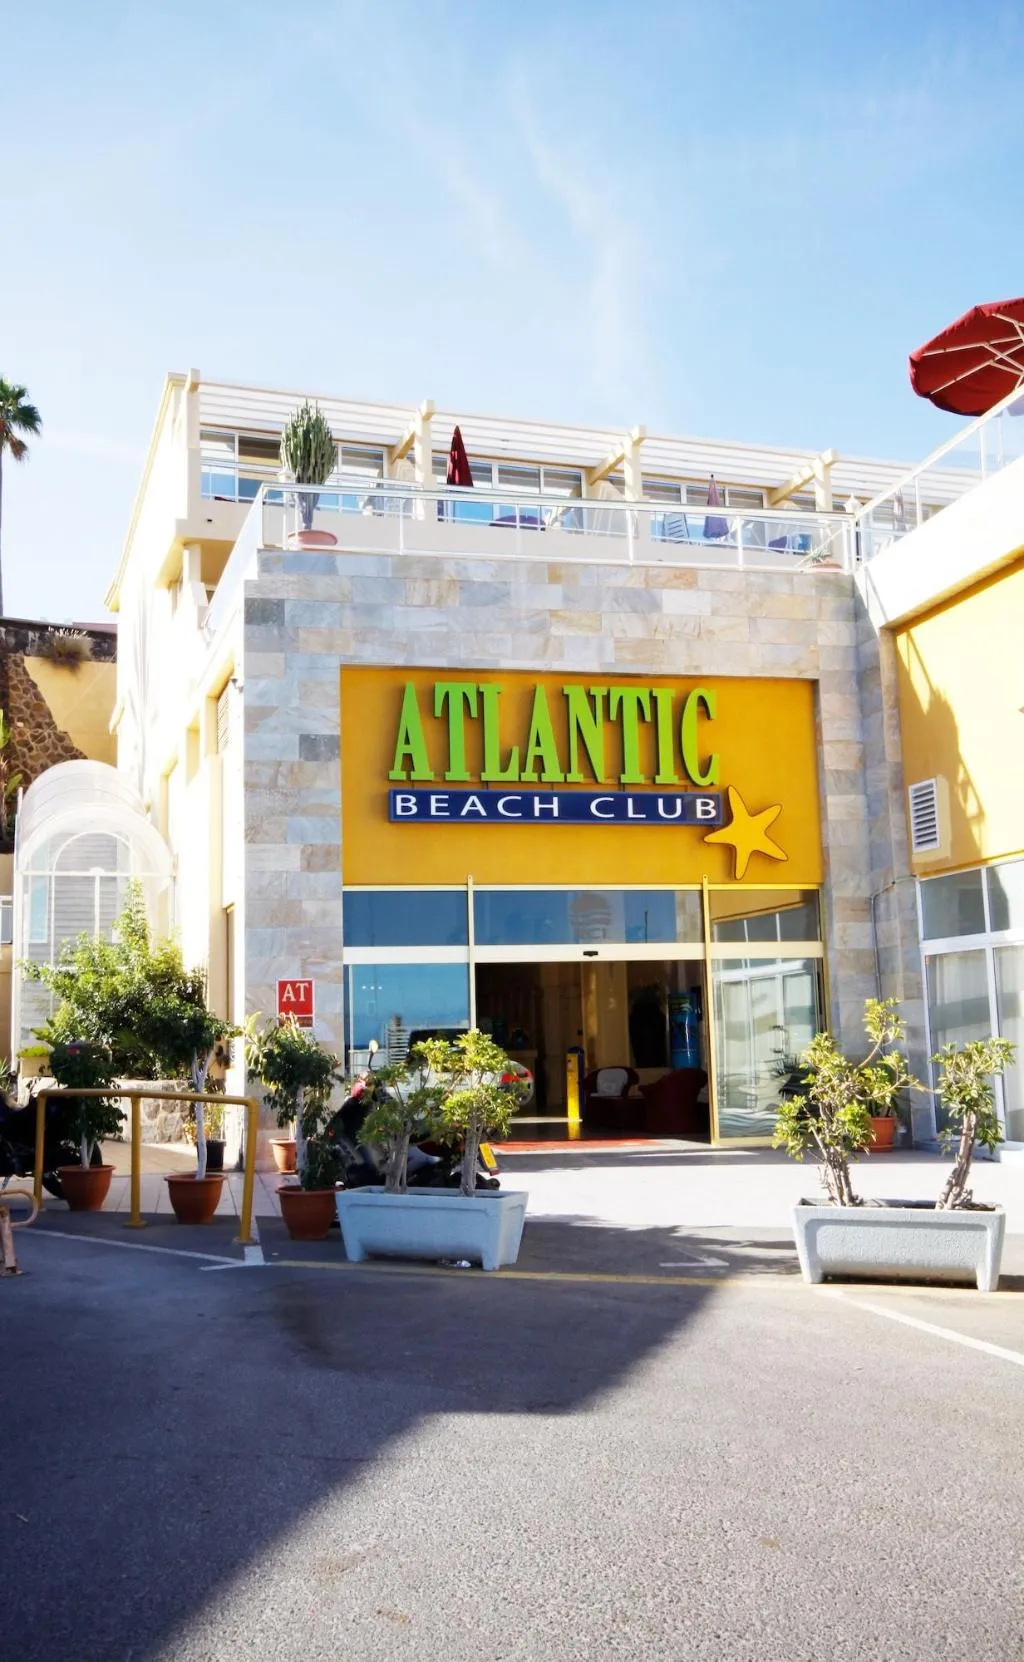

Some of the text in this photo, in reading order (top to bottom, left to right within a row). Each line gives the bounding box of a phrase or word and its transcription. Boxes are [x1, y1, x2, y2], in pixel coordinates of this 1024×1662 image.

[389, 681, 719, 785] ATLANTIC
[395, 794, 717, 819] BEACH CLUB
[281, 982, 309, 1002] AT
